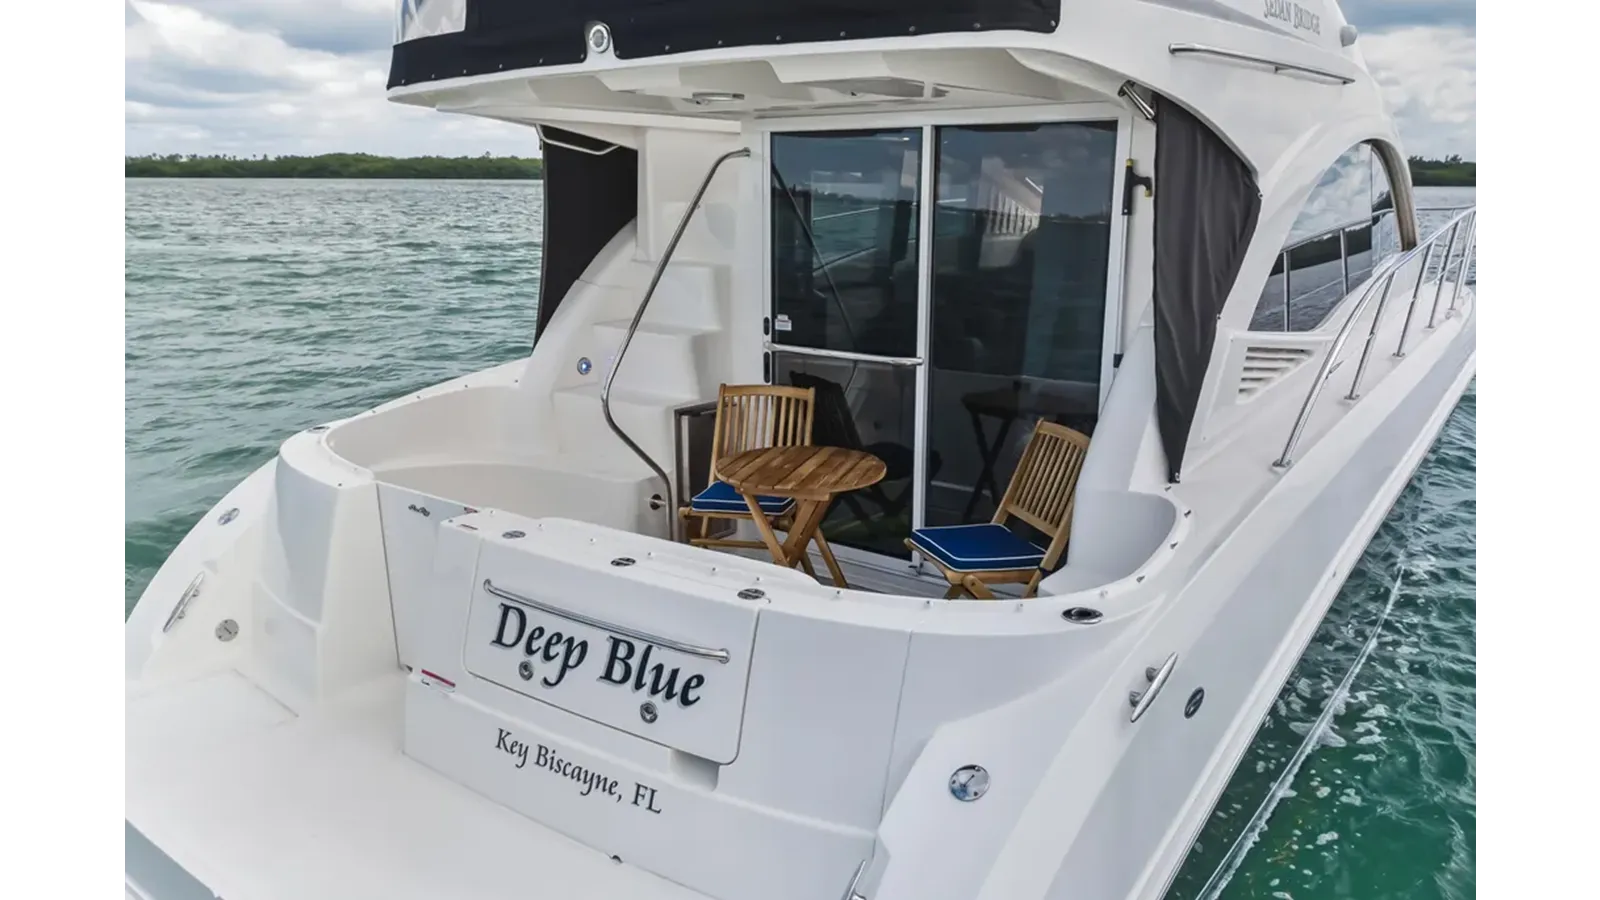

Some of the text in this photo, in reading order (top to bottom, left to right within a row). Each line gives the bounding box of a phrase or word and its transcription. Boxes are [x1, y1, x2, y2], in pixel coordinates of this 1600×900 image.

[1264, 0, 1320, 35] SEDAN BRIDGE
[490, 602, 706, 707] Deep Blue
[495, 728, 662, 814] Key Biscayne, FL
